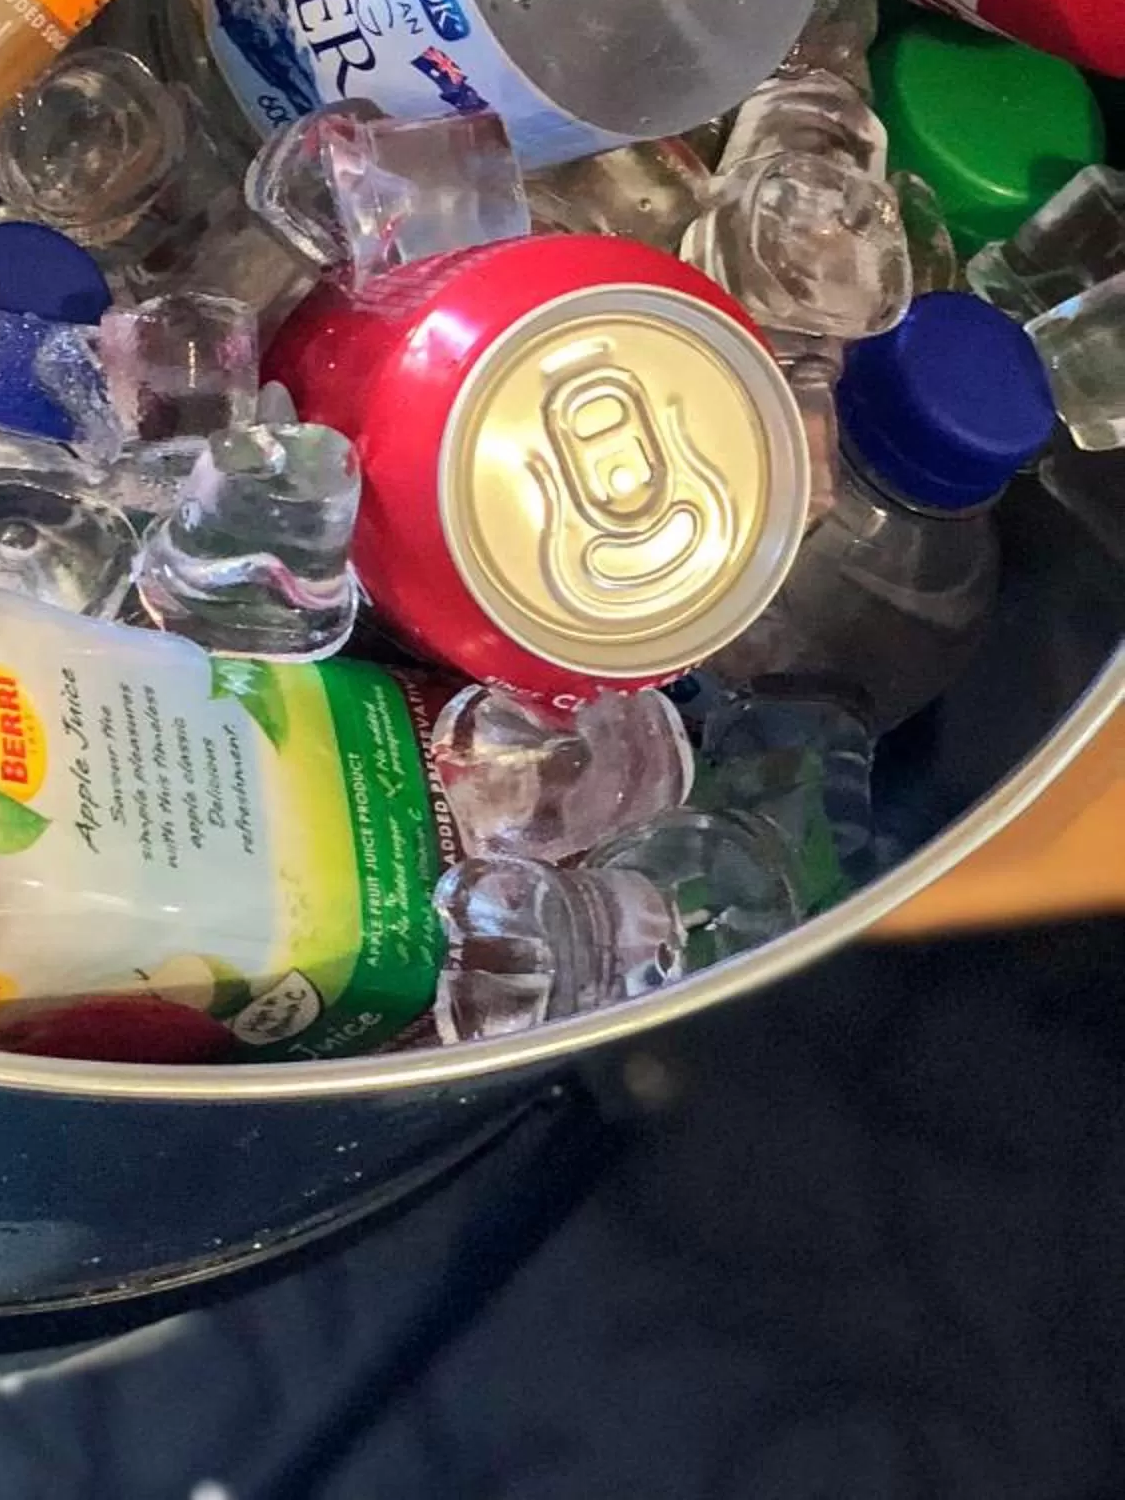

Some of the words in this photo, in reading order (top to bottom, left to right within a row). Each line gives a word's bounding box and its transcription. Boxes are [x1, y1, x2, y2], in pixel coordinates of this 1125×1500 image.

[61, 667, 89, 751] Juice
[100, 704, 117, 740] the
[69, 757, 102, 854] Apple
[348, 751, 372, 824] PRODUCT
[361, 828, 378, 872] JUICE
[434, 800, 456, 866] ADDED
